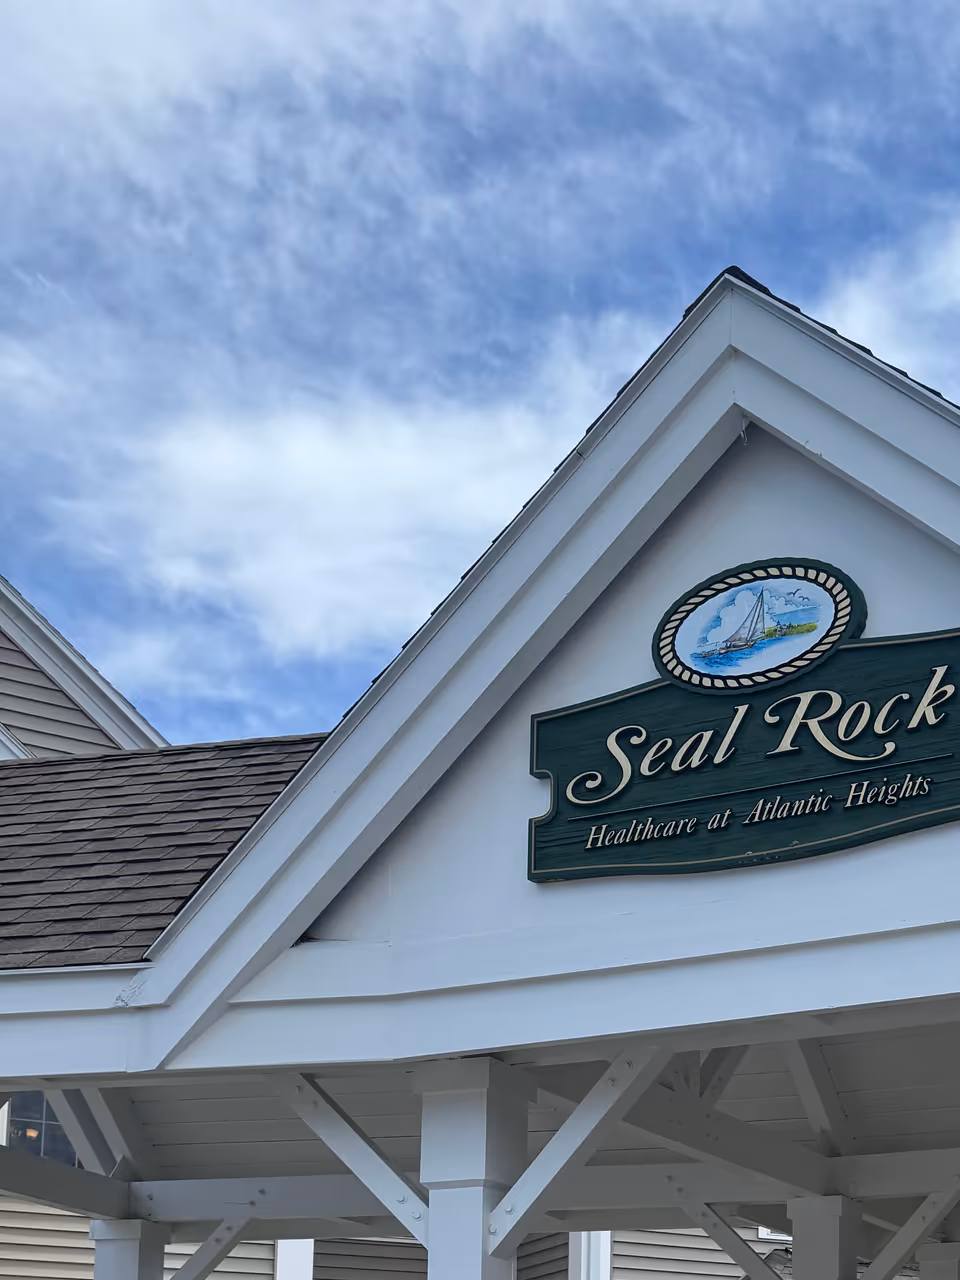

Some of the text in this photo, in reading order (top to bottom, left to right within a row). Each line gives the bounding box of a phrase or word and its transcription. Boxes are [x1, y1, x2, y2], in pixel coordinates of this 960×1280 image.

[566, 665, 956, 804] Seal Rock
[585, 774, 931, 850] Healthcare at Atlantic Heights
